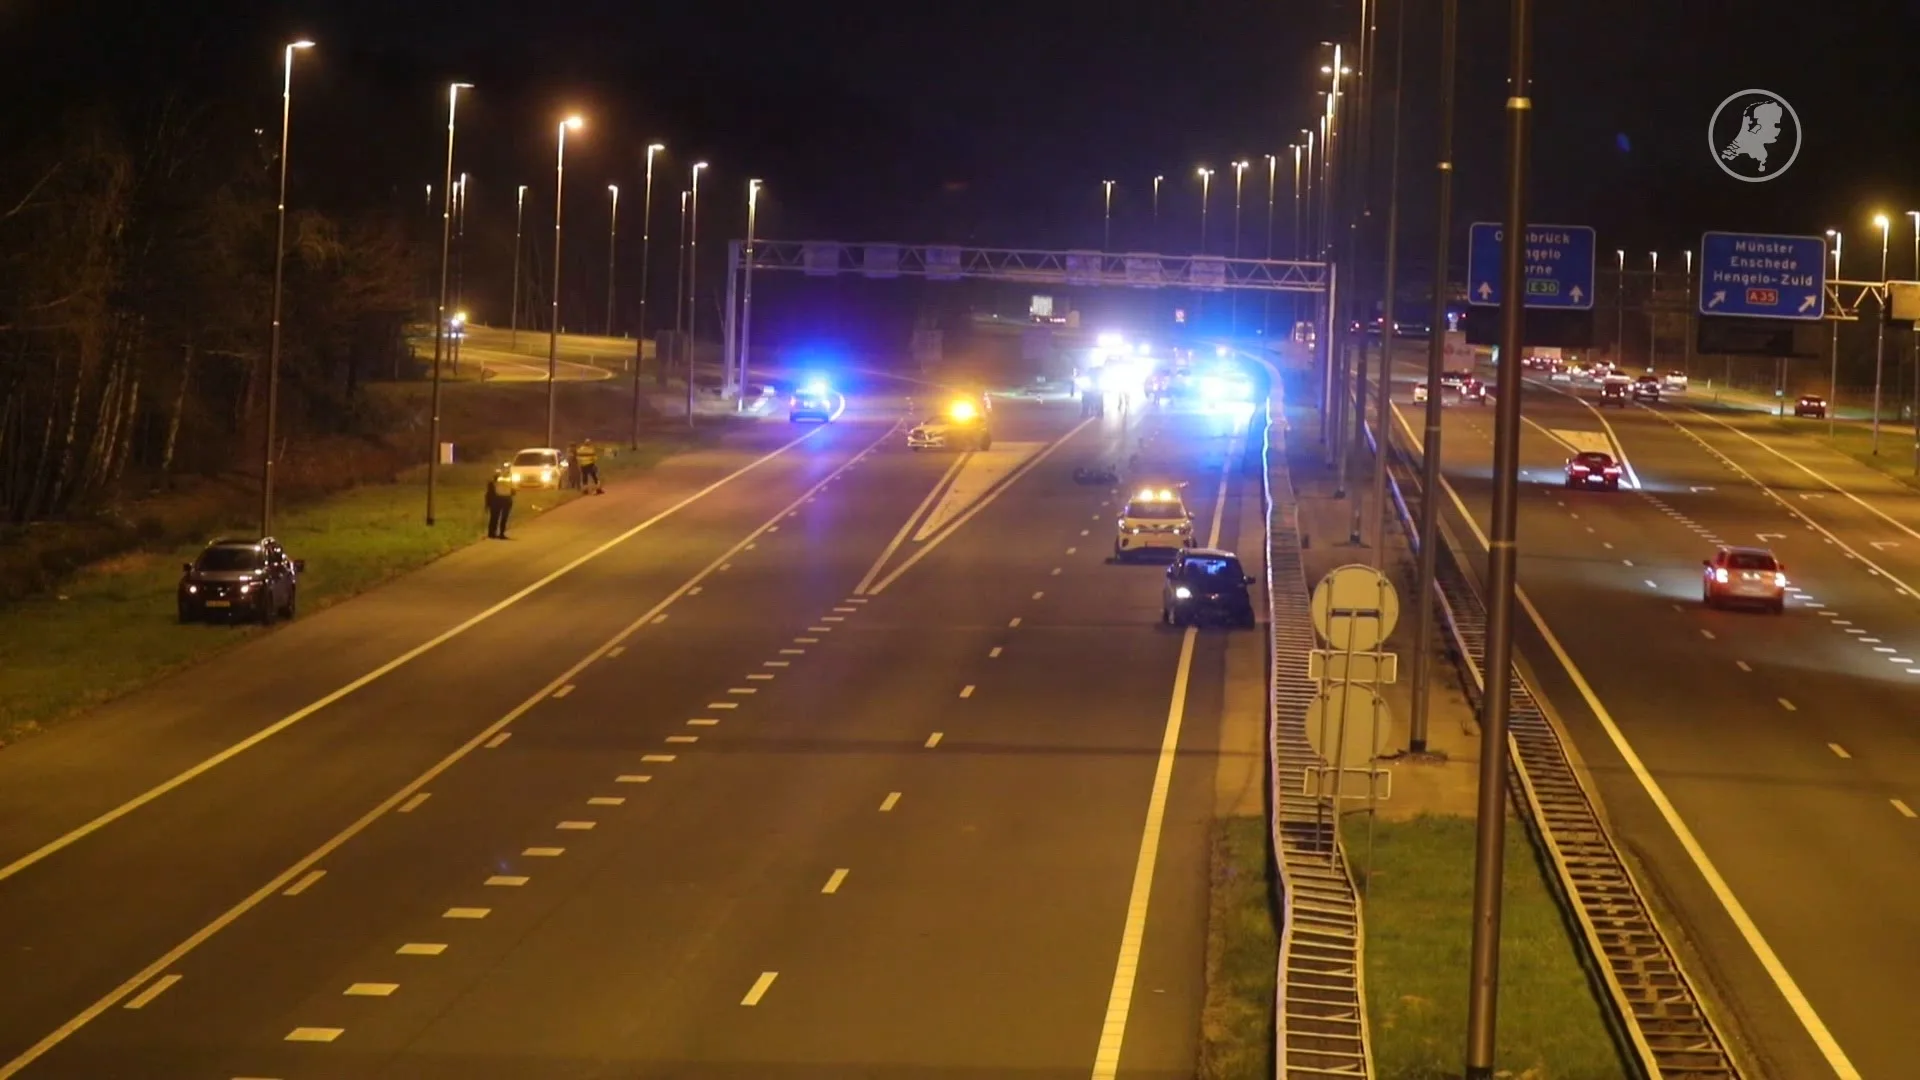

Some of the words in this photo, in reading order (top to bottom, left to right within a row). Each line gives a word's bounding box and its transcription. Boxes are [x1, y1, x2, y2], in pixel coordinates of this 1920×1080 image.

[1495, 231, 1570, 244] Obrück
[1735, 241, 1793, 253] Münster
[1730, 256, 1797, 269] Enschede
